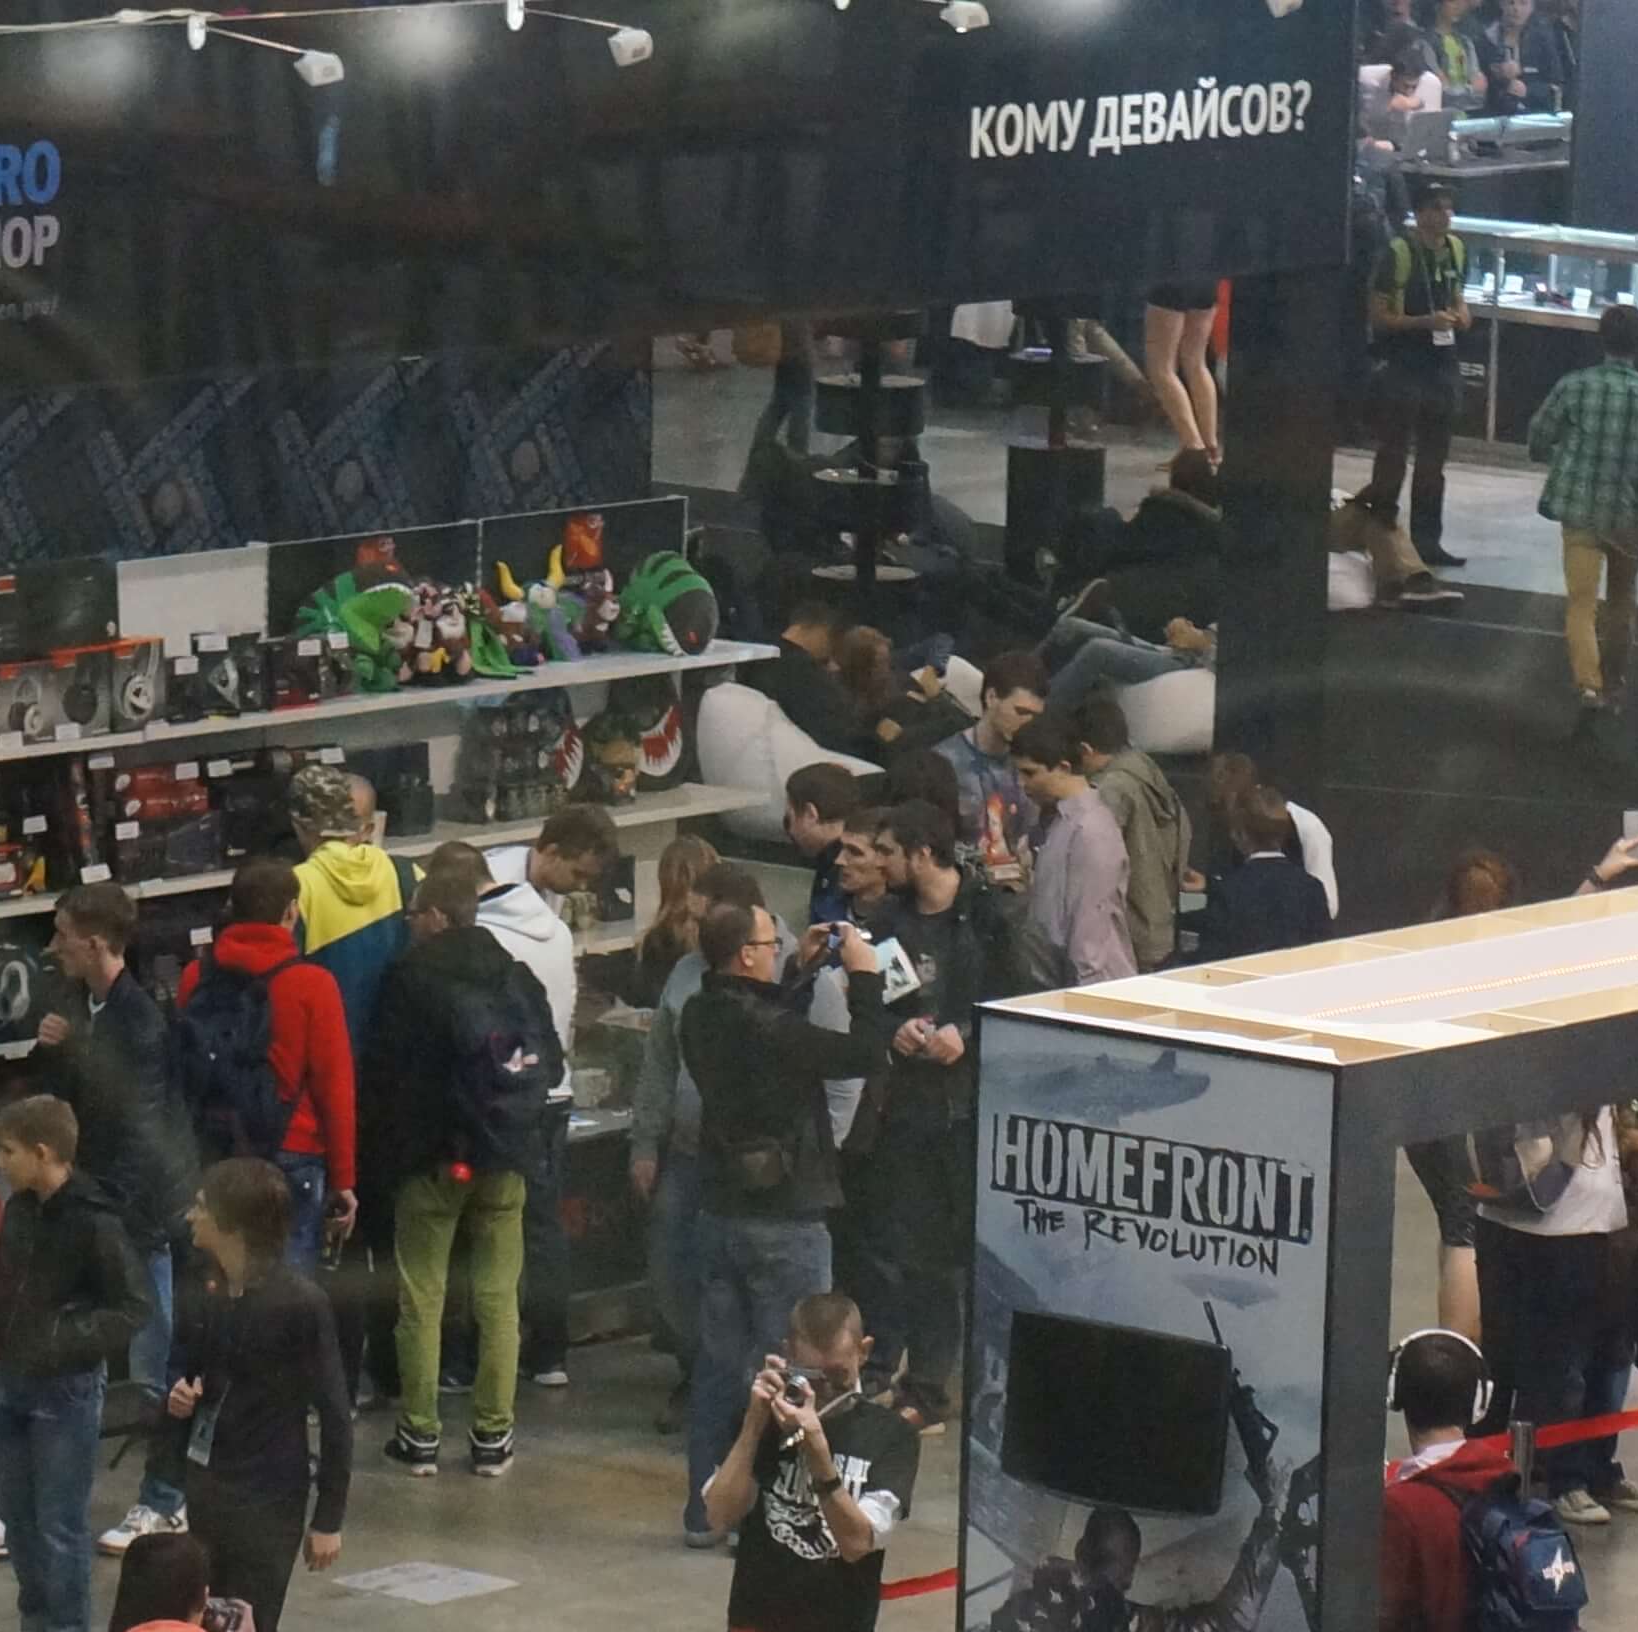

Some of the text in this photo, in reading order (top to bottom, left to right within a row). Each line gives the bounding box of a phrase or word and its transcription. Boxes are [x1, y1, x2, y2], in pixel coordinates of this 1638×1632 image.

[970, 76, 1312, 159] КОМУ ДЕВАЙСОВ?
[993, 1115, 1315, 1241] HOMEFRONT
[1014, 1198, 1279, 1276] THE REVOLUTION
